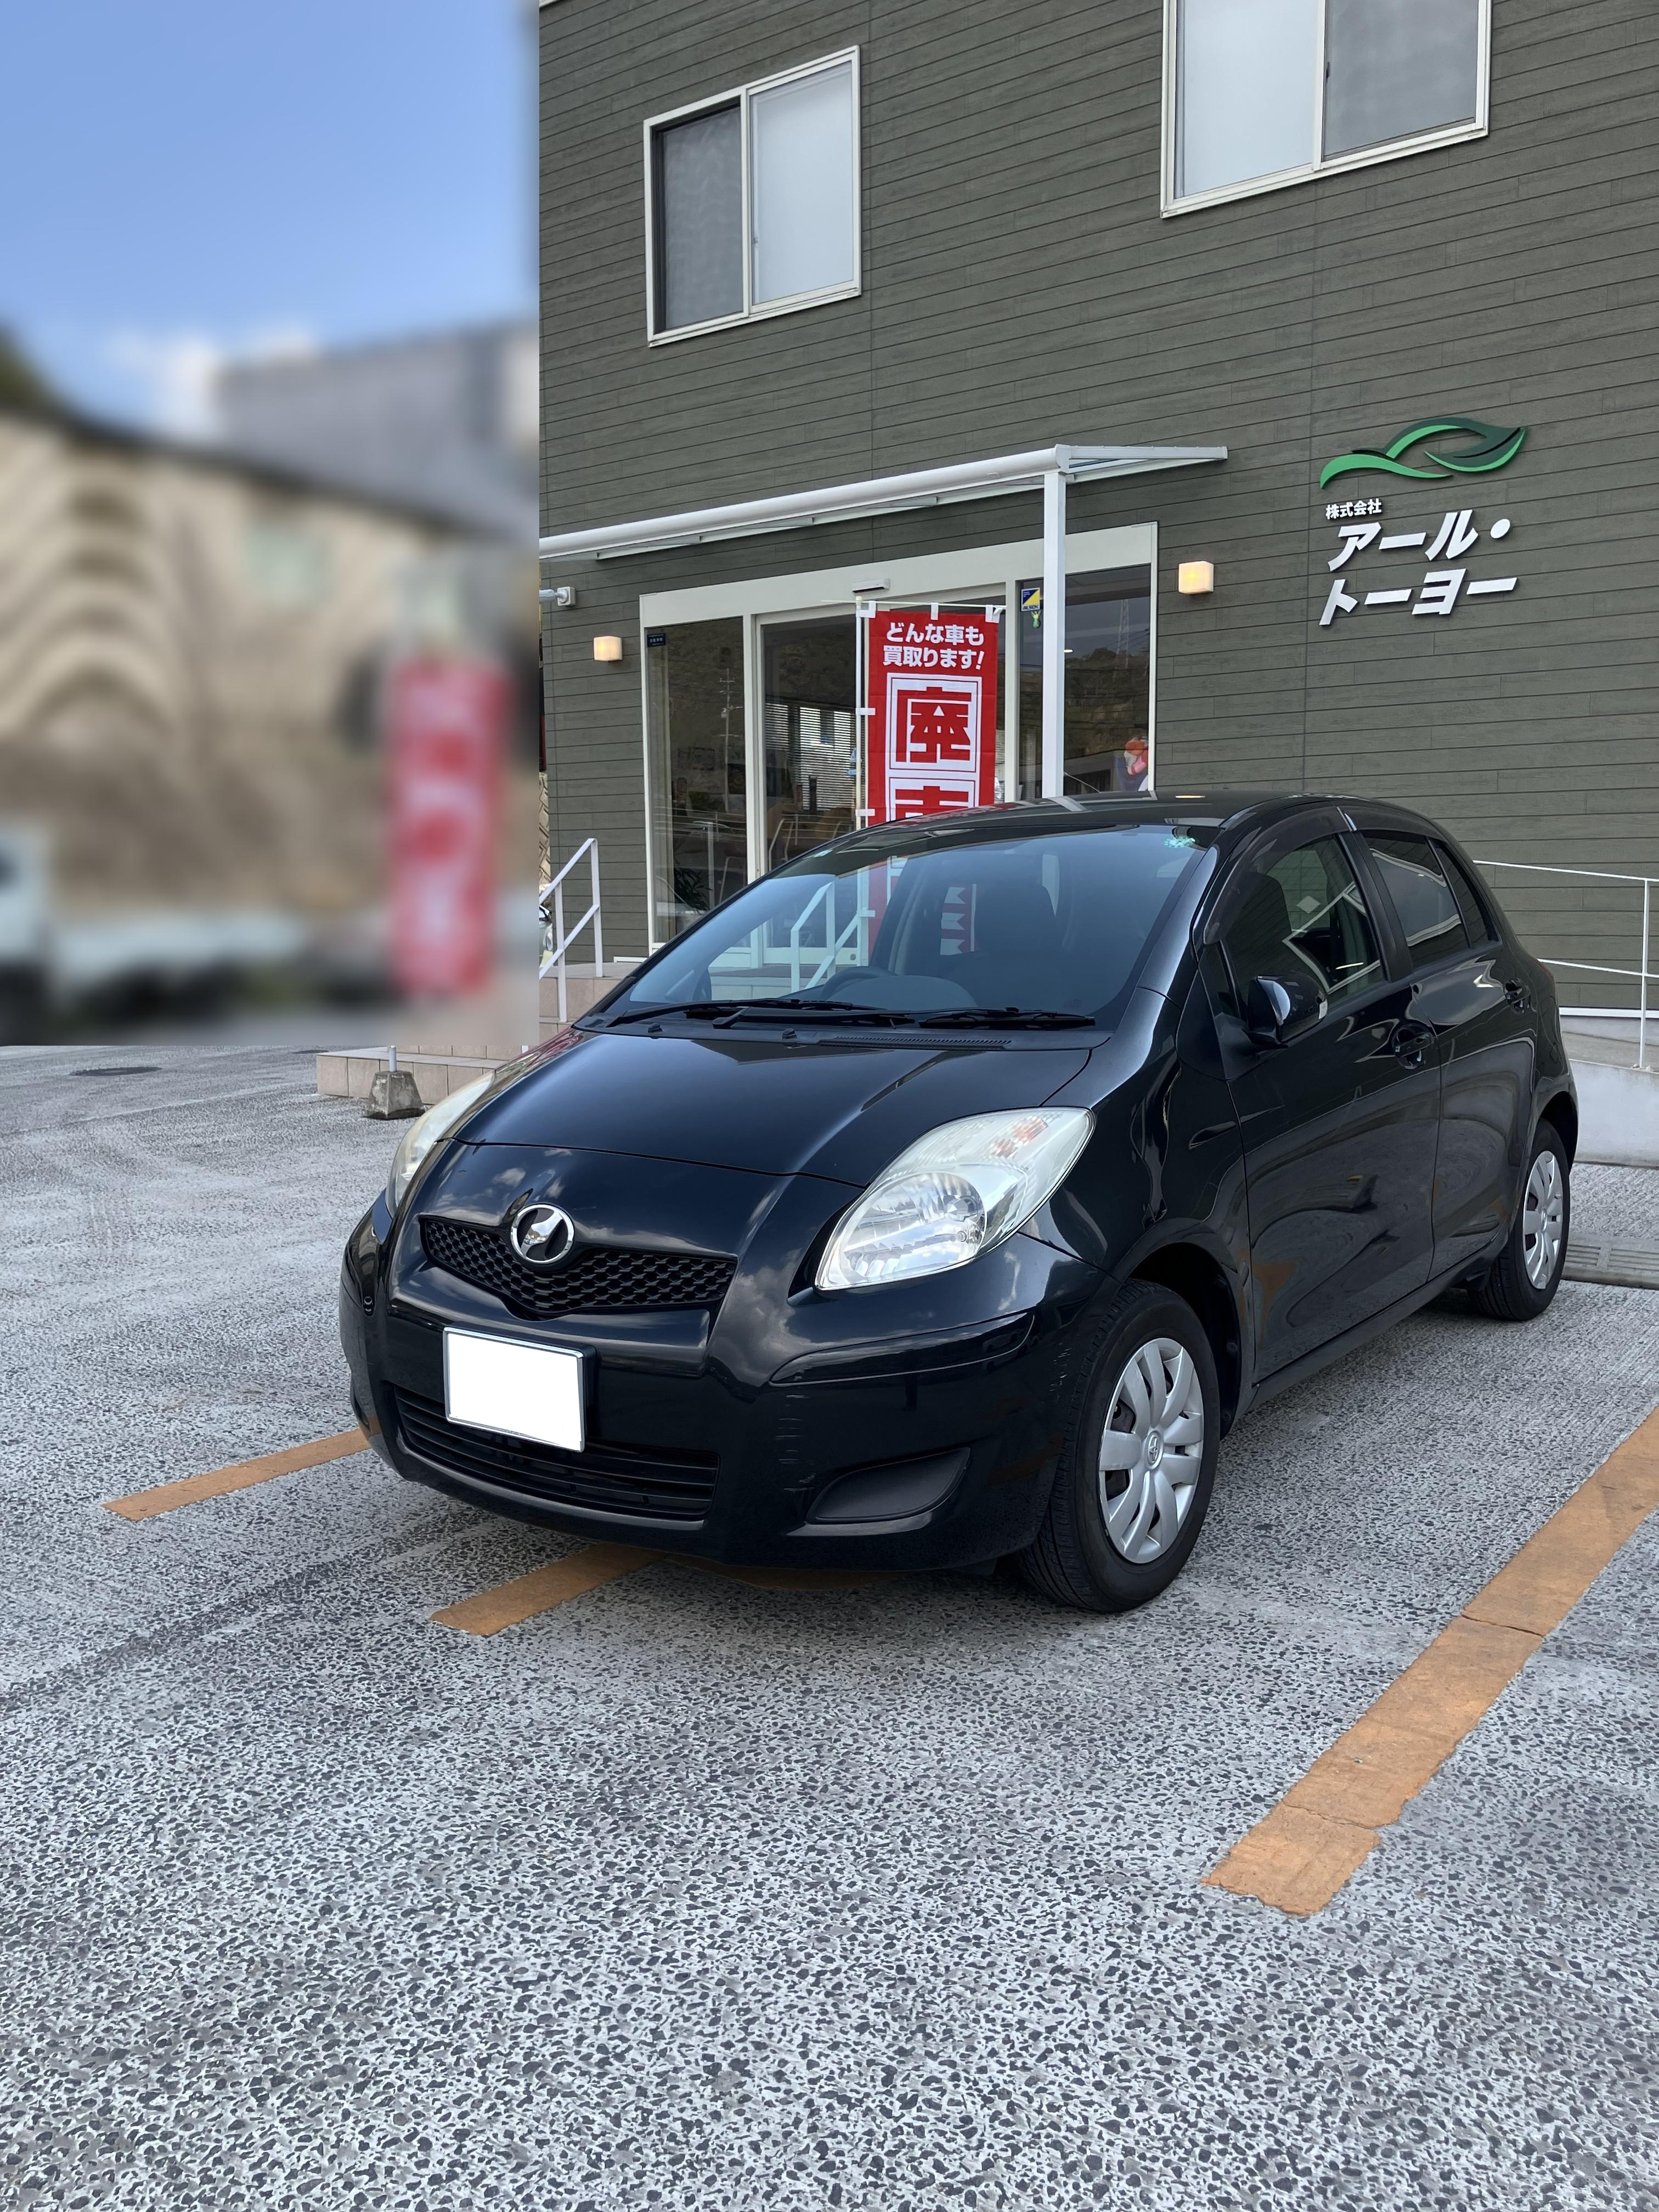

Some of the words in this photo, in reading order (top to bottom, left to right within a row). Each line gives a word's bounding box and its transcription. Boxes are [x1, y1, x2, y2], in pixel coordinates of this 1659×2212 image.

[1325, 498, 1382, 520] 株式会社
[1319, 568, 1518, 626] トーヨー
[886, 622, 984, 646] どんな車も
[883, 645, 985, 670] 買取ります!
